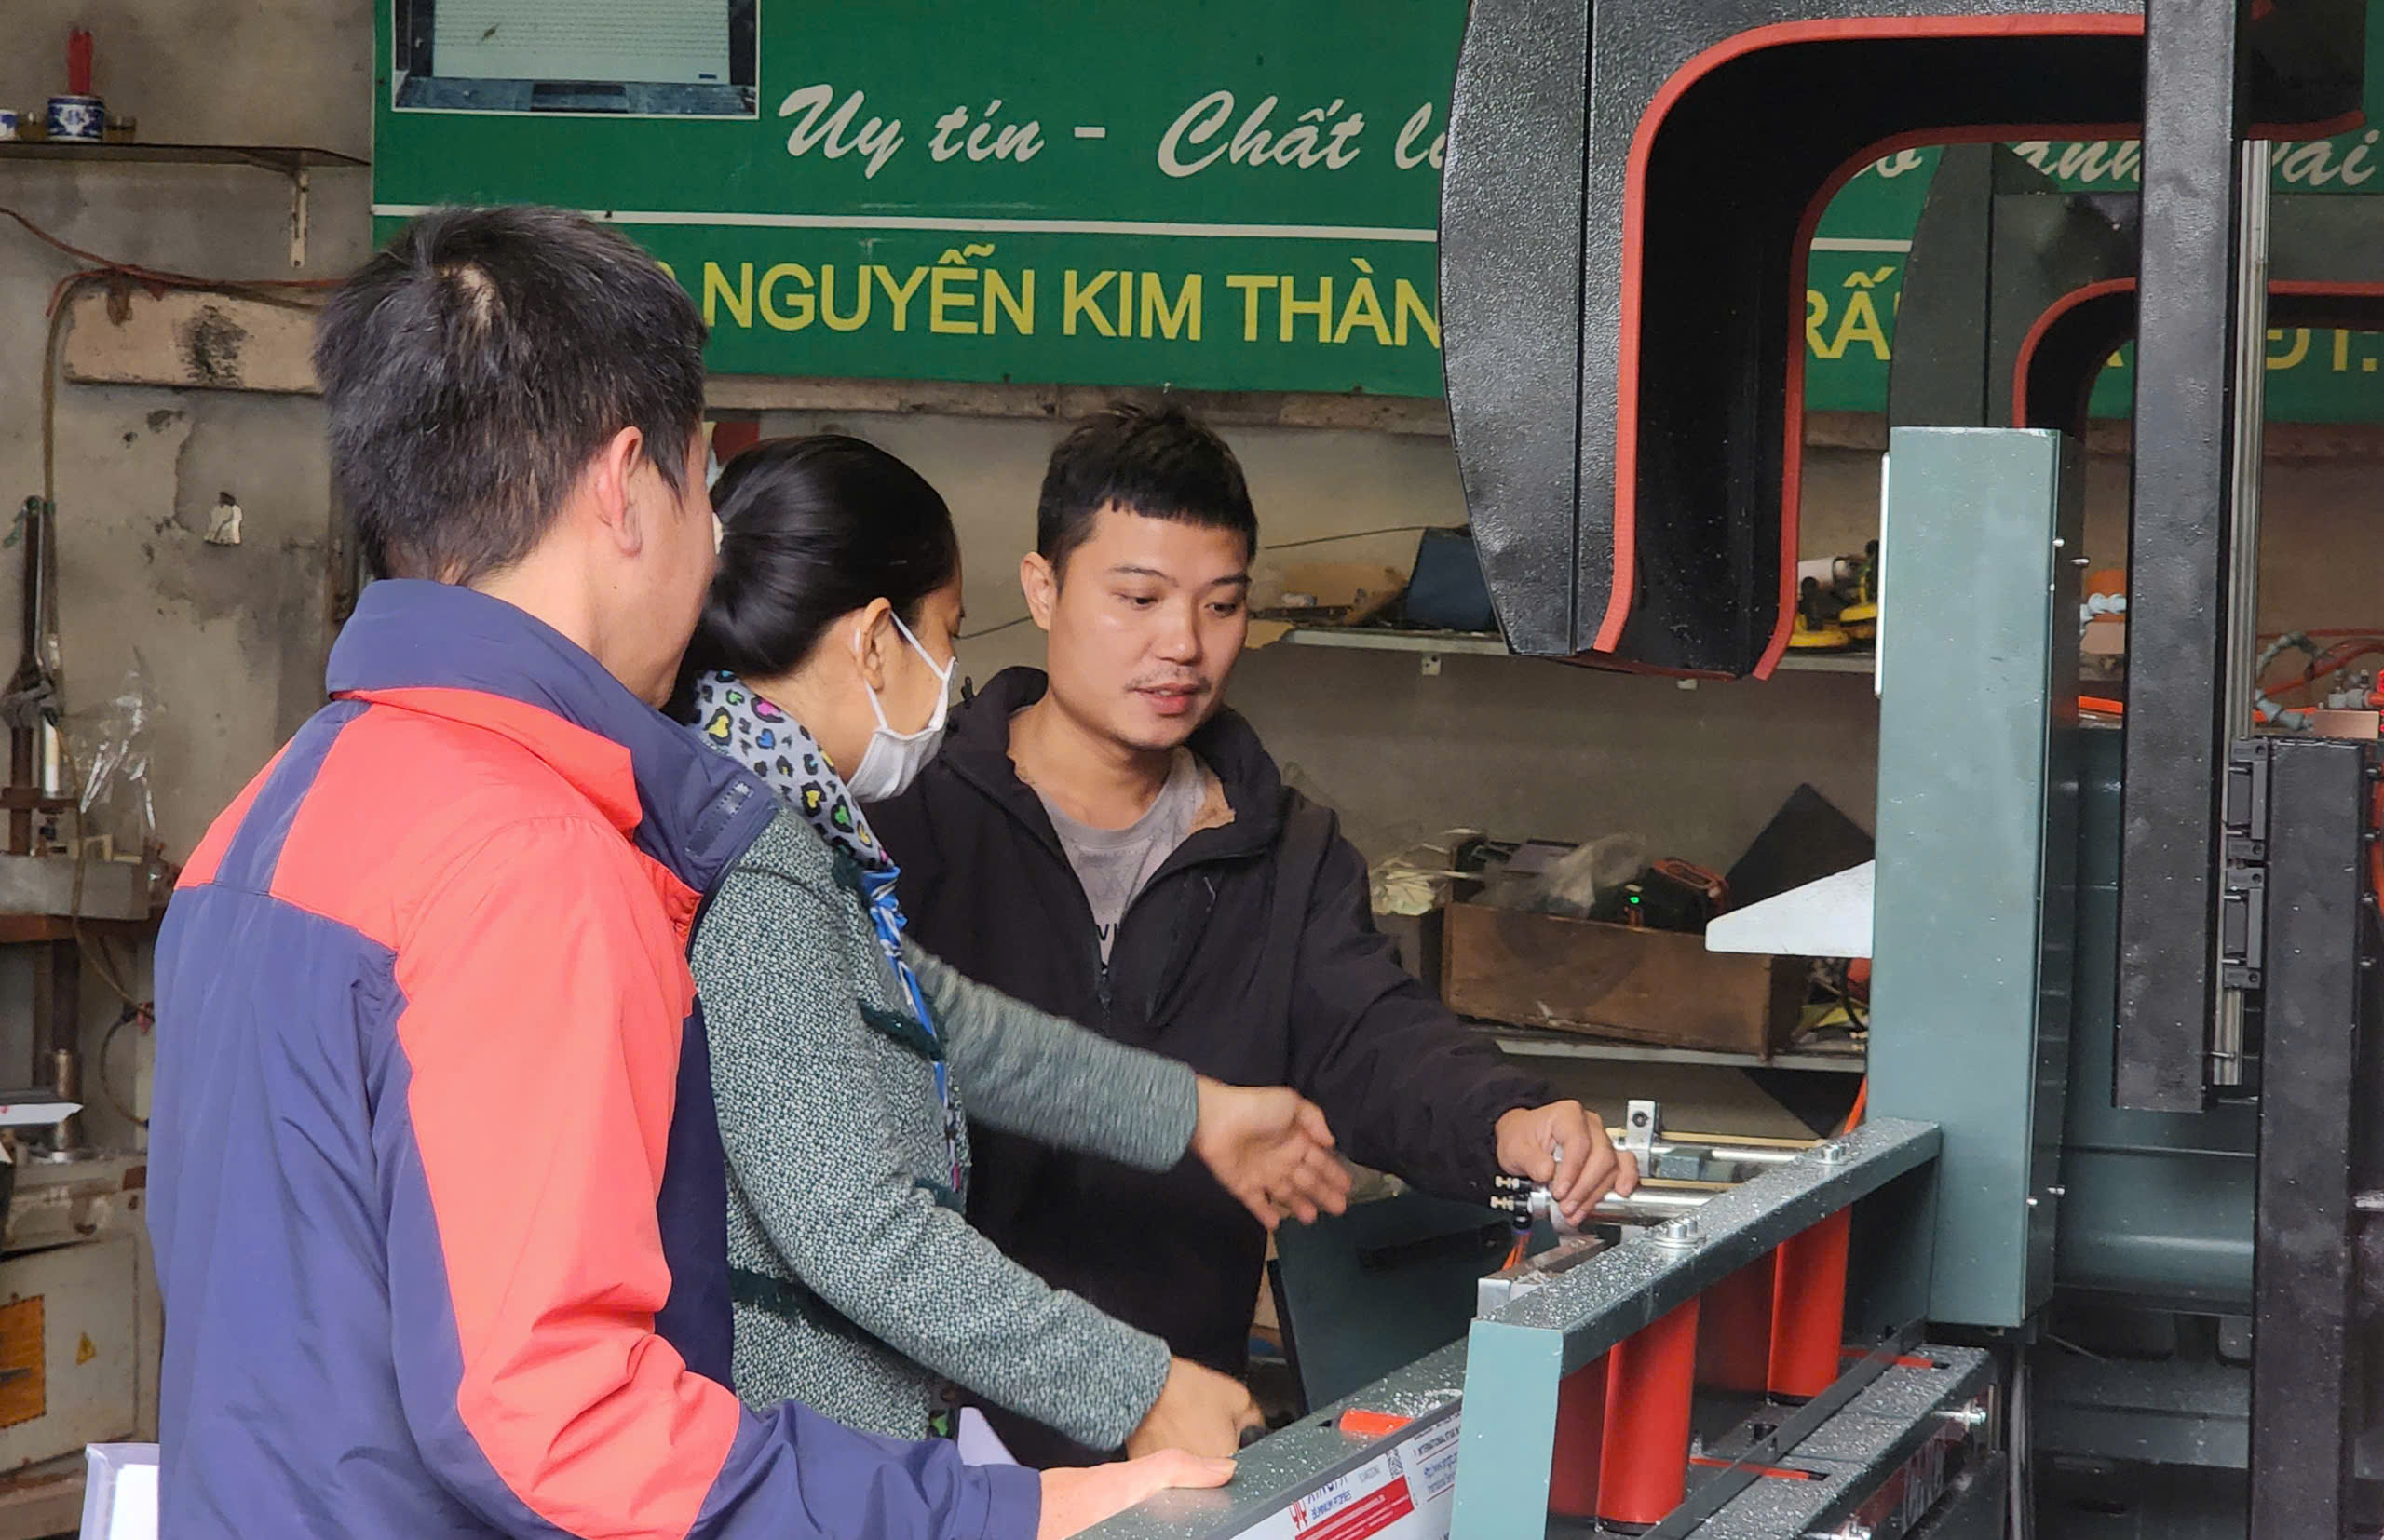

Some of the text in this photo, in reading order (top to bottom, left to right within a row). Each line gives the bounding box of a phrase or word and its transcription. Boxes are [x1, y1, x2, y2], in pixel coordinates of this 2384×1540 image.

[779, 84, 904, 179] Uy
[928, 100, 1044, 162] tín
[1158, 90, 1365, 178] Chất
[703, 243, 1035, 335] NGUYỄN
[1063, 270, 1202, 341] KIM
